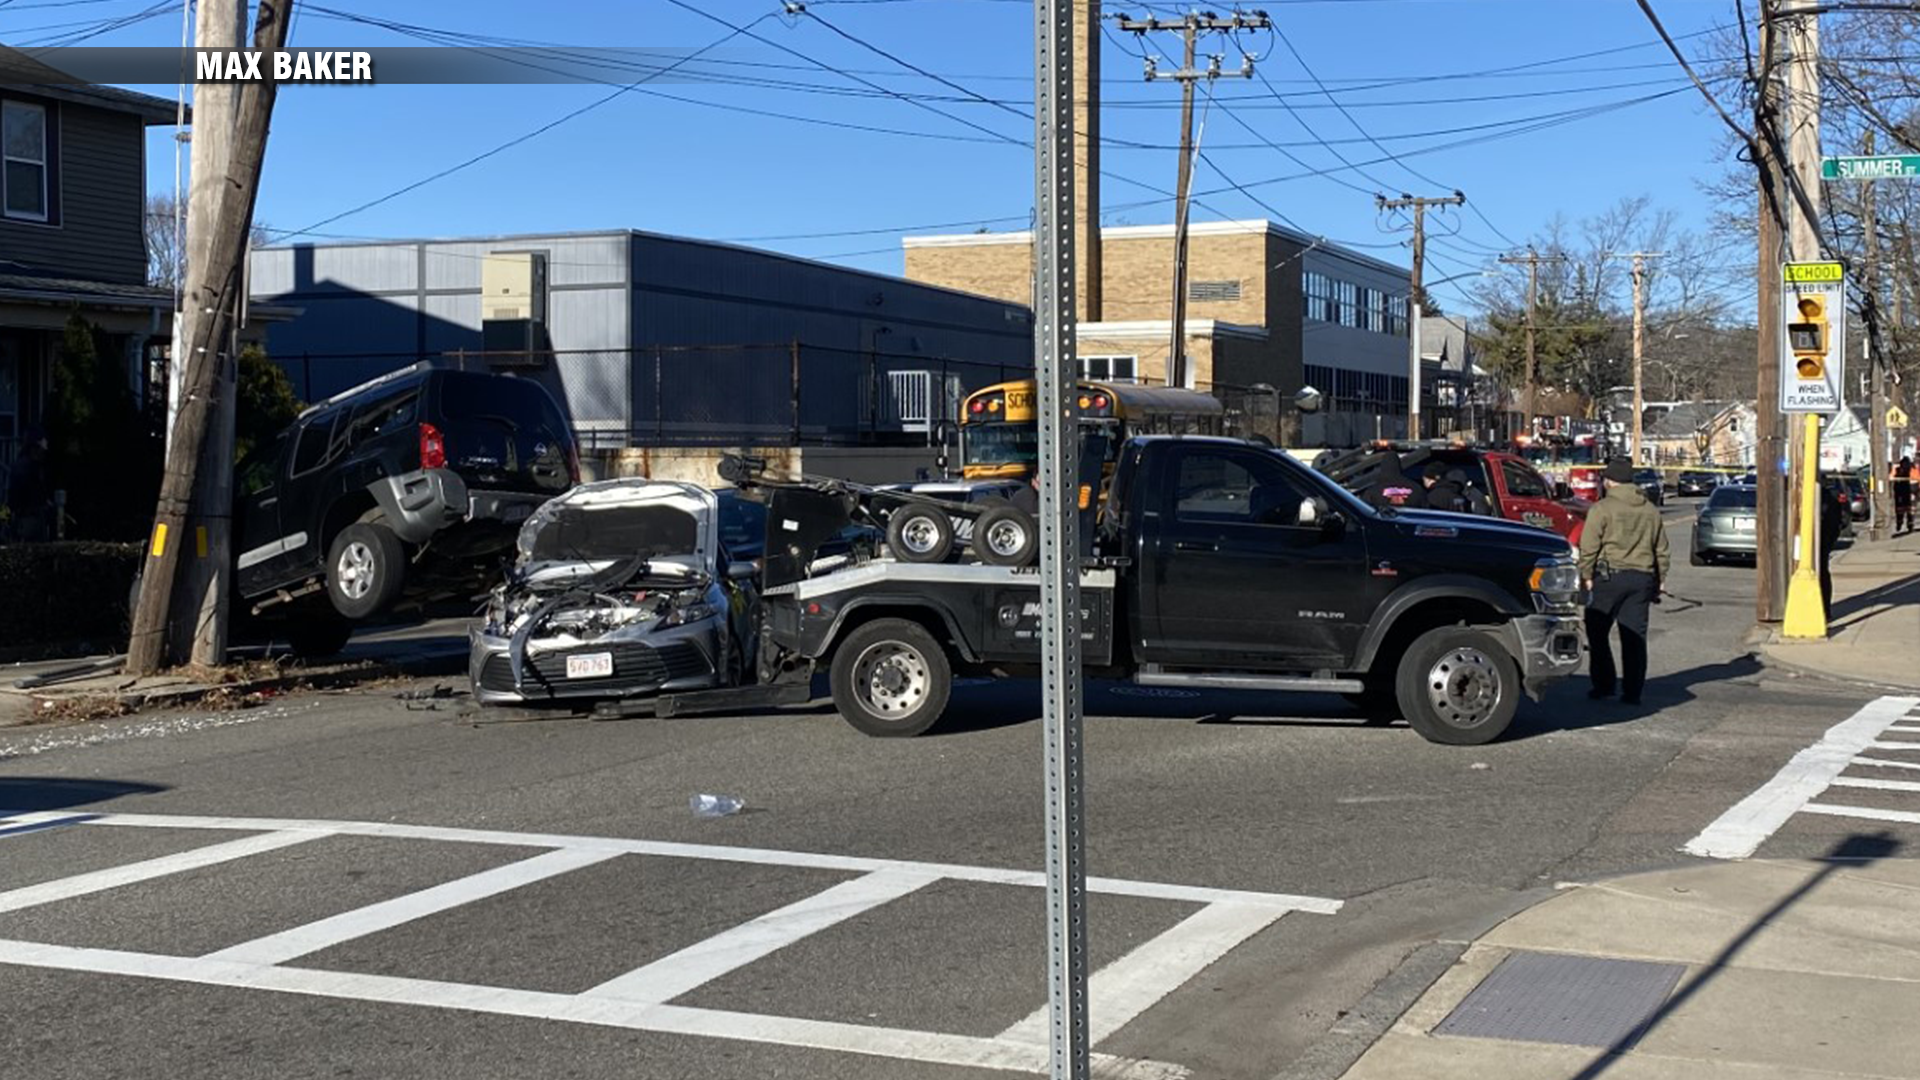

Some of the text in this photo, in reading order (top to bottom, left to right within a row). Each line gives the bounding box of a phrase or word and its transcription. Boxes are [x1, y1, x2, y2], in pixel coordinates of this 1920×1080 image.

[1838, 160, 1902, 178] SUMMER
[1787, 266, 1839, 279] SCHOOL
[1786, 283, 1841, 293] SPEED LIMIT
[1798, 384, 1825, 394] WHEN
[1787, 395, 1834, 405] FLASHING
[1298, 610, 1345, 619] RAM
